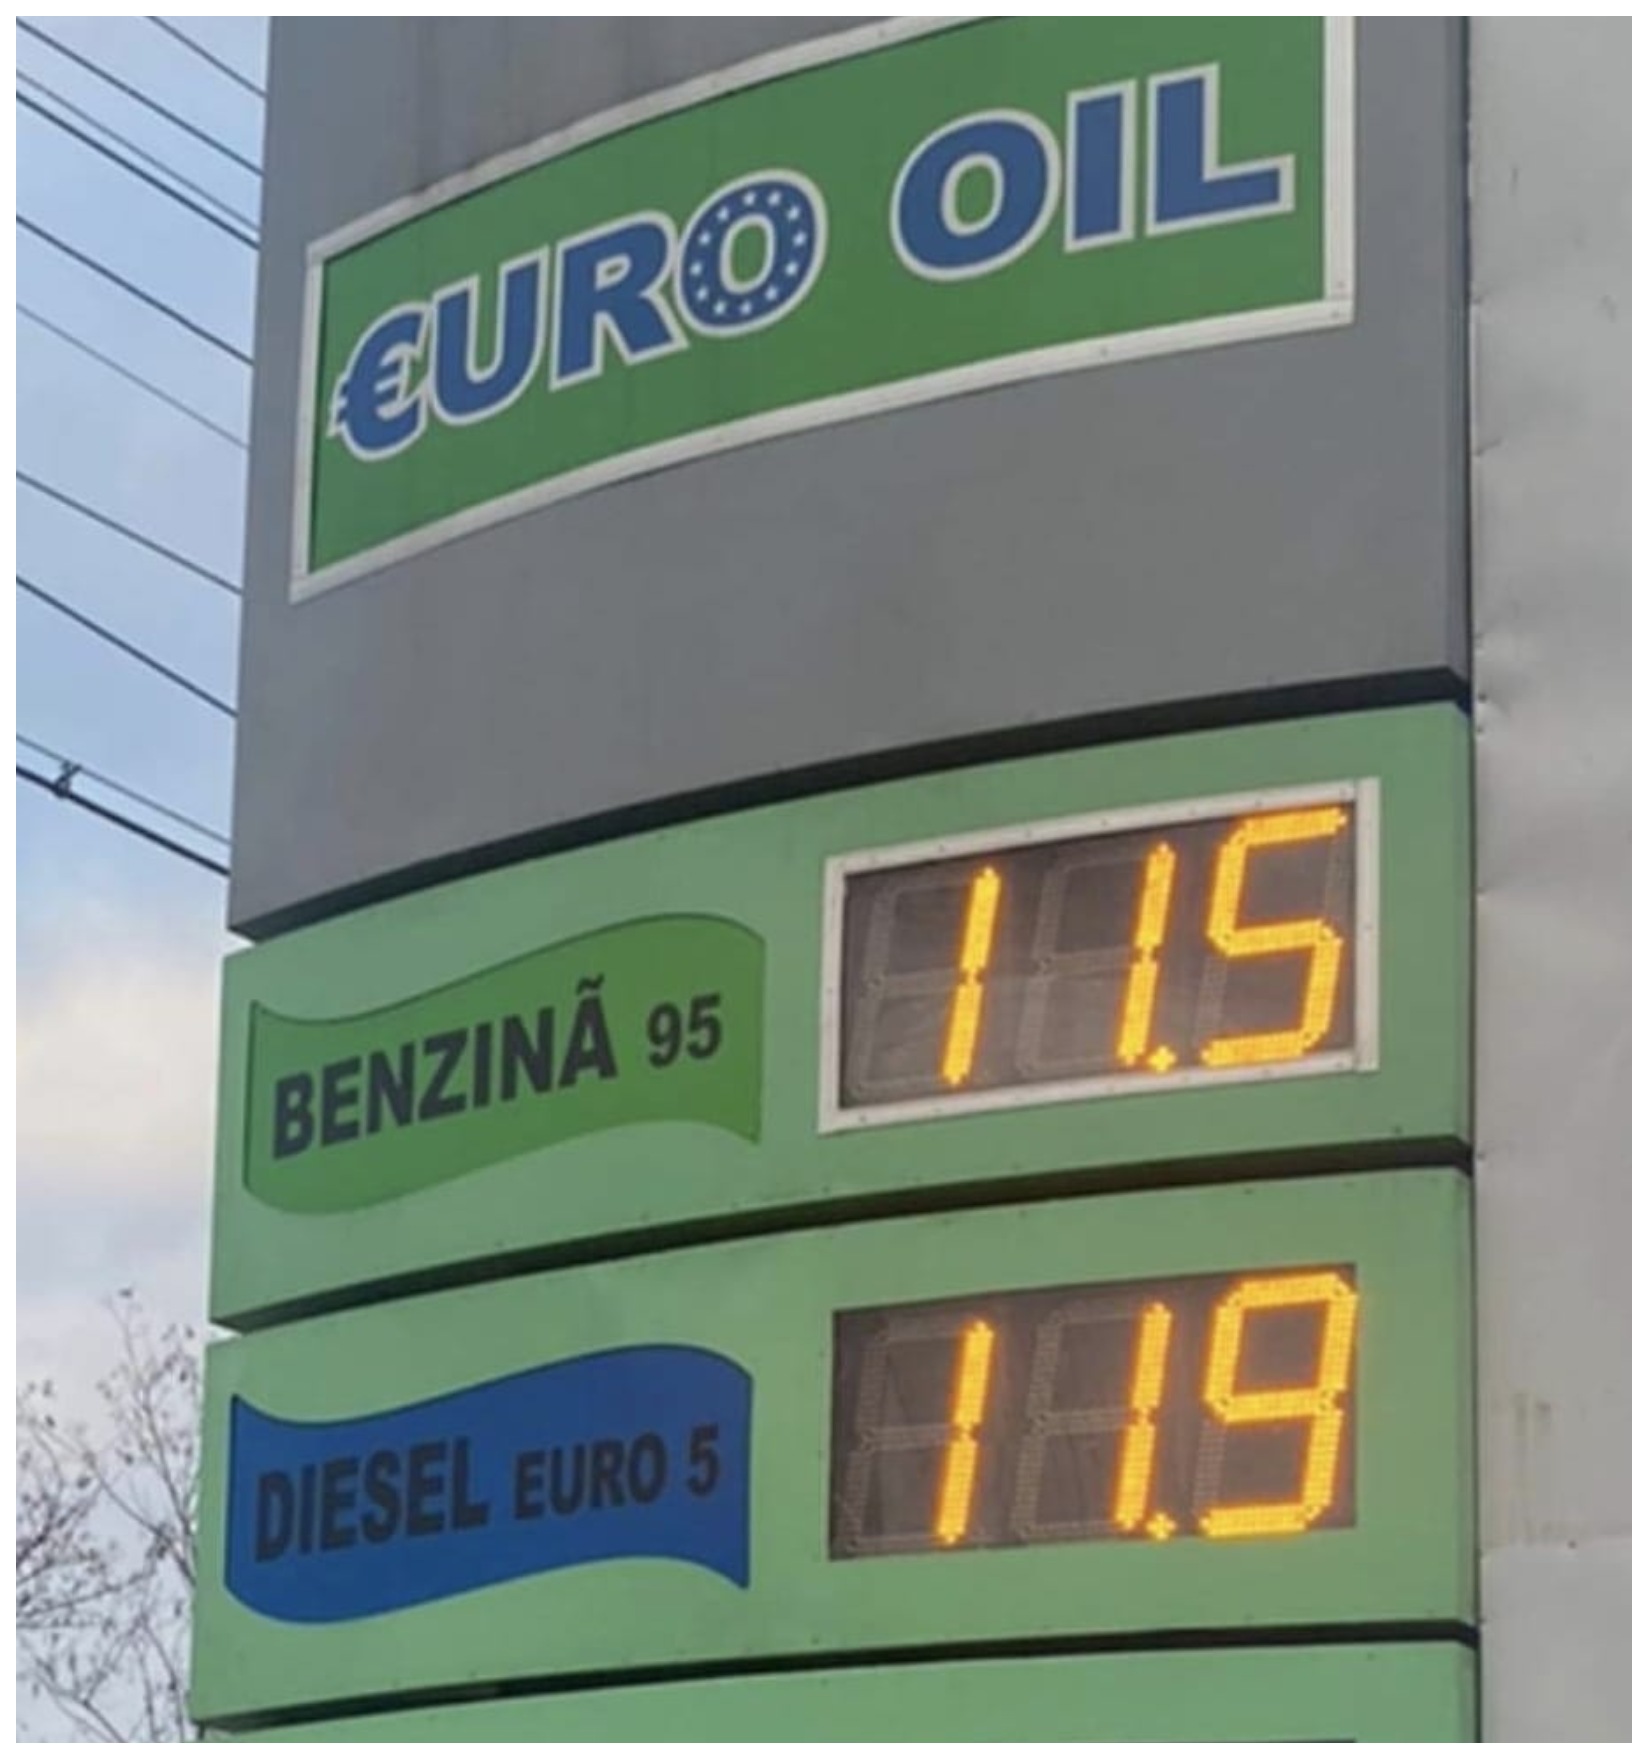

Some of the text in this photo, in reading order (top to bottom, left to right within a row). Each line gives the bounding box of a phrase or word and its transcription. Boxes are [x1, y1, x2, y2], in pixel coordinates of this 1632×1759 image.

[890, 62, 1296, 284] OIL
[646, 992, 724, 1070] 95
[936, 805, 1348, 1088] 11.5
[254, 1423, 720, 1563] DIESEL EURO 5
[935, 1271, 1359, 1547] 11.9
